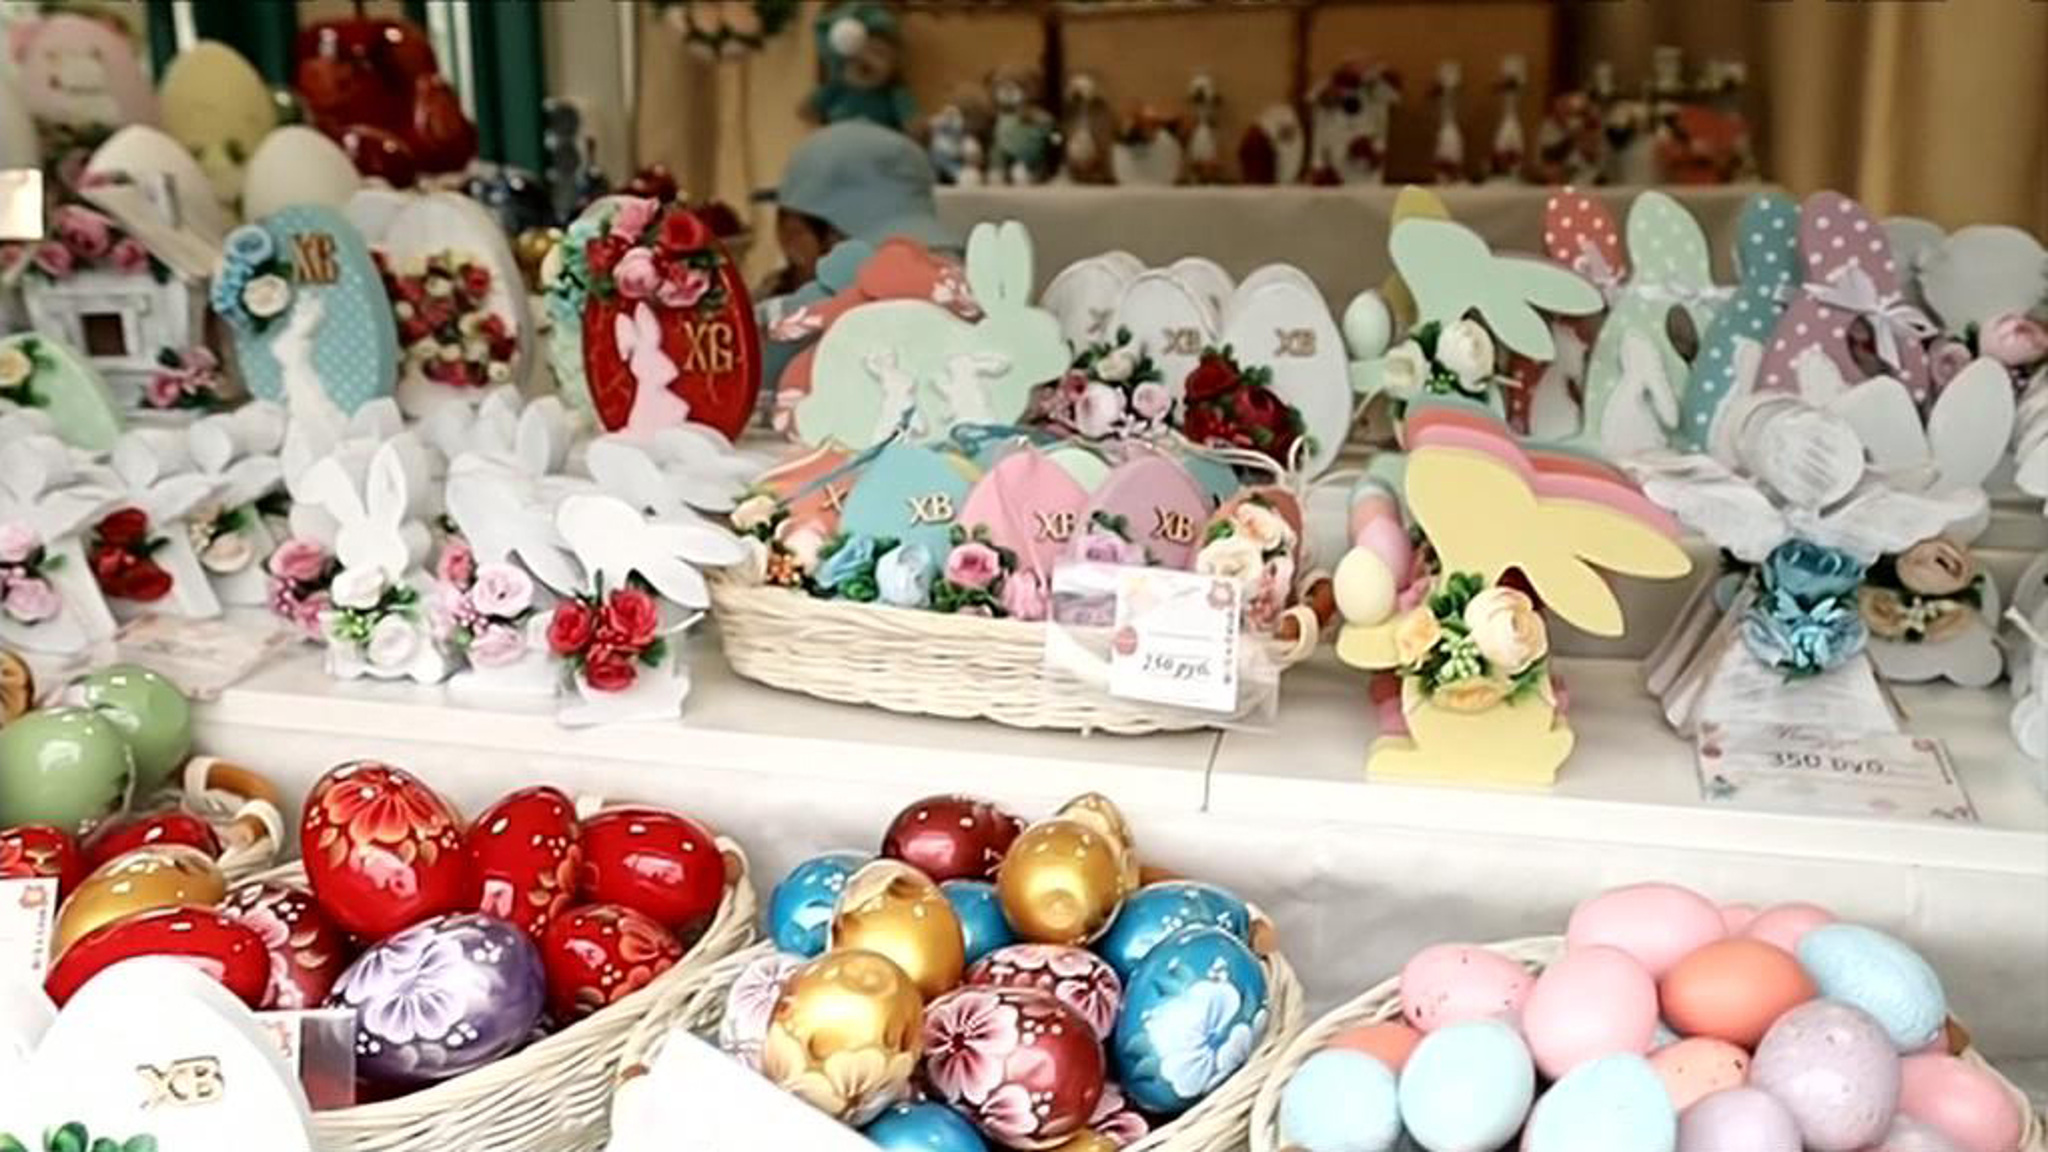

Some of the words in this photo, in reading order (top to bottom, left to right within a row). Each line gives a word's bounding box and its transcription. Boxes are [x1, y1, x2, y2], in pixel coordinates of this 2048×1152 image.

[1274, 327, 1316, 358] ХВ
[909, 491, 956, 527] ХВ
[1151, 506, 1195, 546] ХВ
[136, 1055, 226, 1110] ХВ
